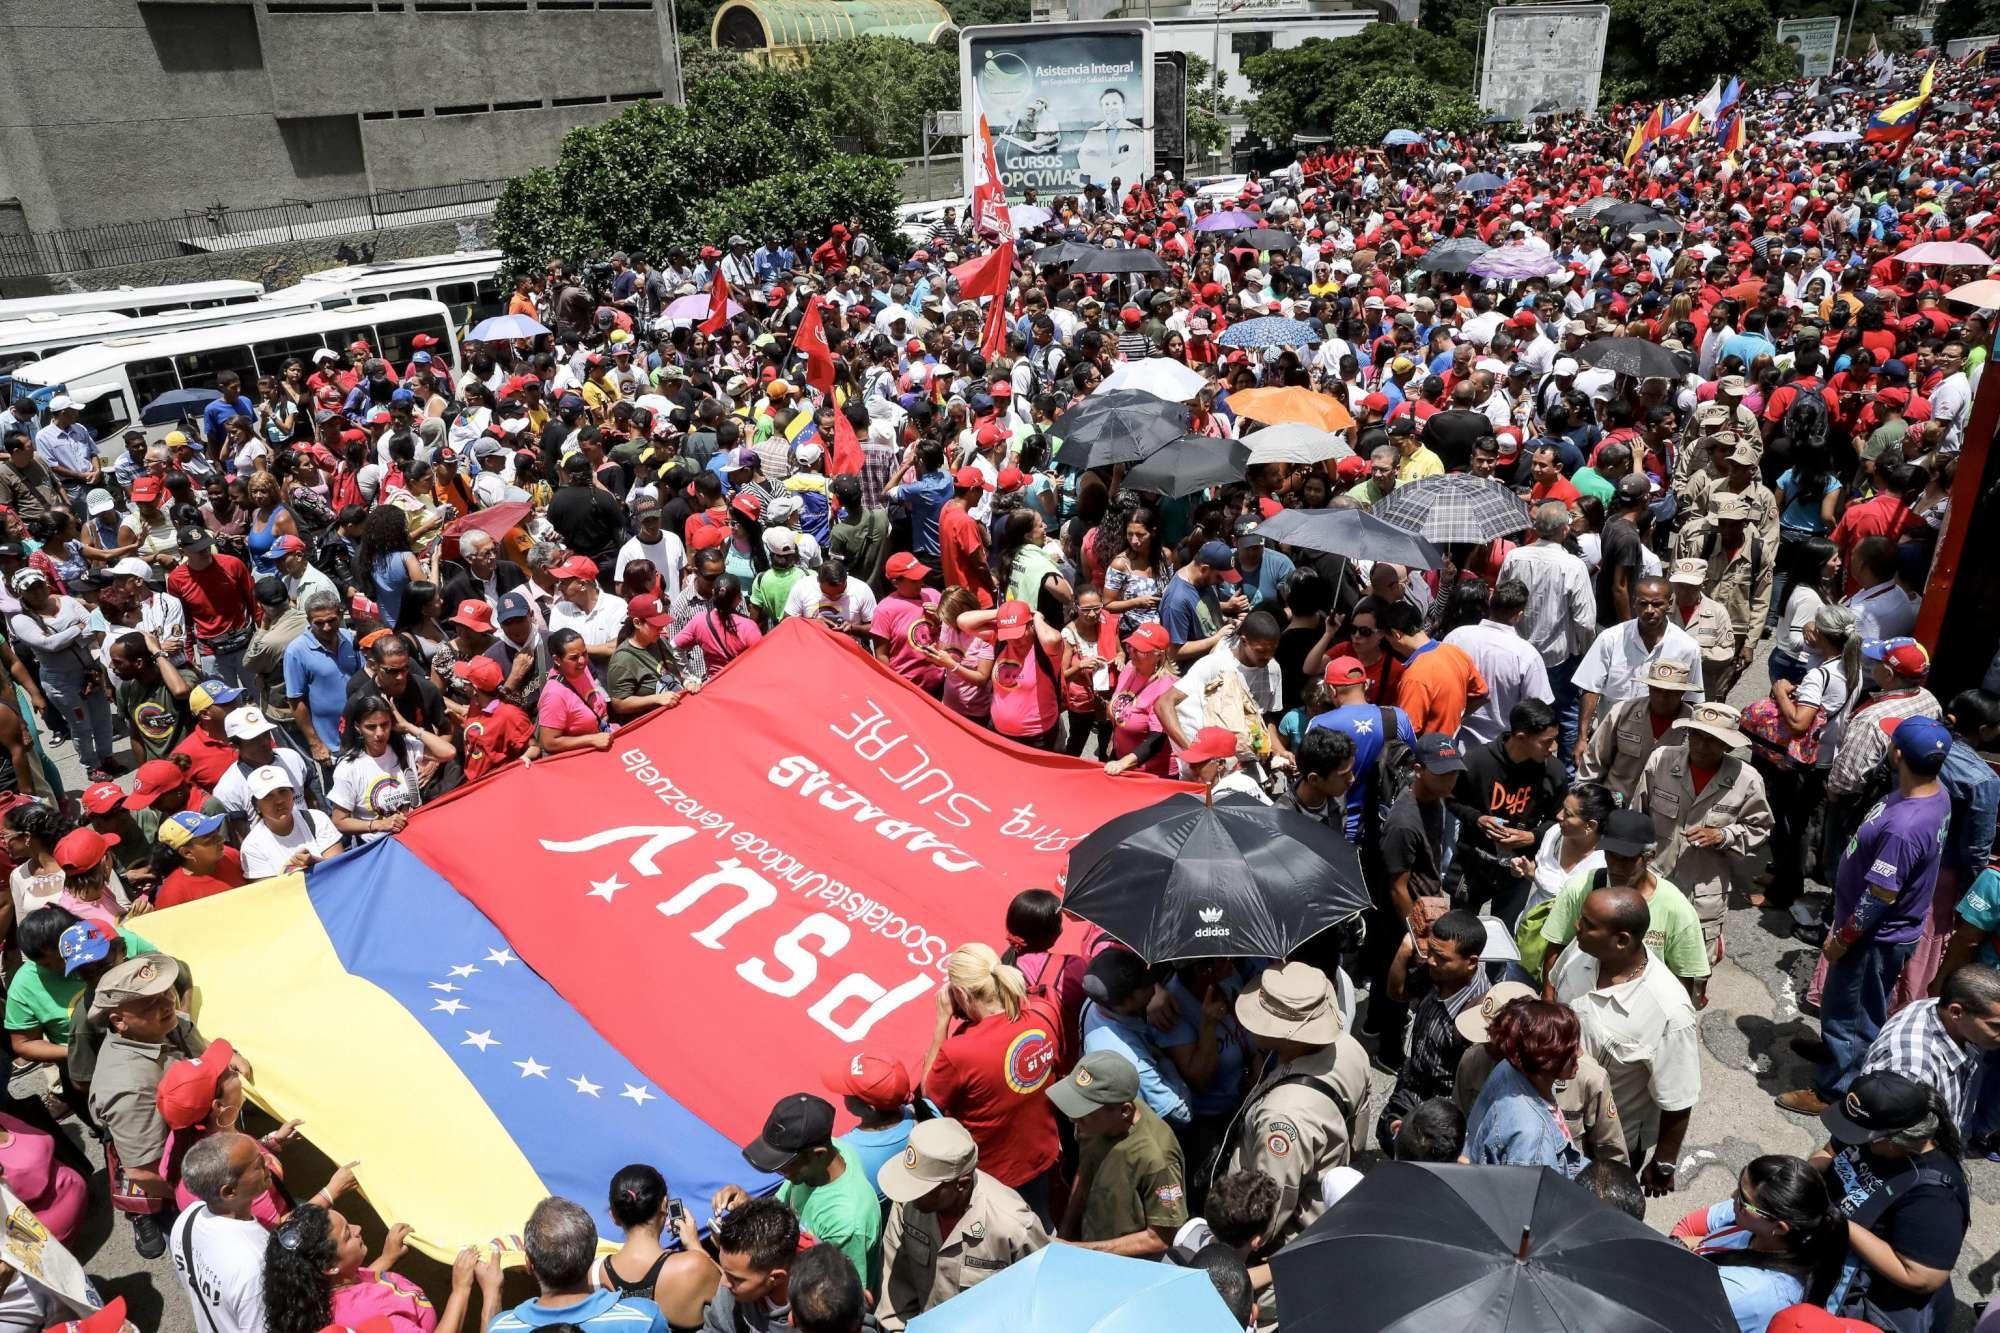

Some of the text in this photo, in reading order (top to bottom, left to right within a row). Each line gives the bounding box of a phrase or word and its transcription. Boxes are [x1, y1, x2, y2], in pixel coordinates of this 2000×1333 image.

[1035, 60, 1134, 77] Asistencia Integral
[1010, 155, 1063, 169] CURSOS
[621, 748, 735, 839] Venezuela
[829, 699, 991, 828] SUCRE
[1490, 781, 1532, 815] Duff
[540, 826, 937, 1043] PSUV
